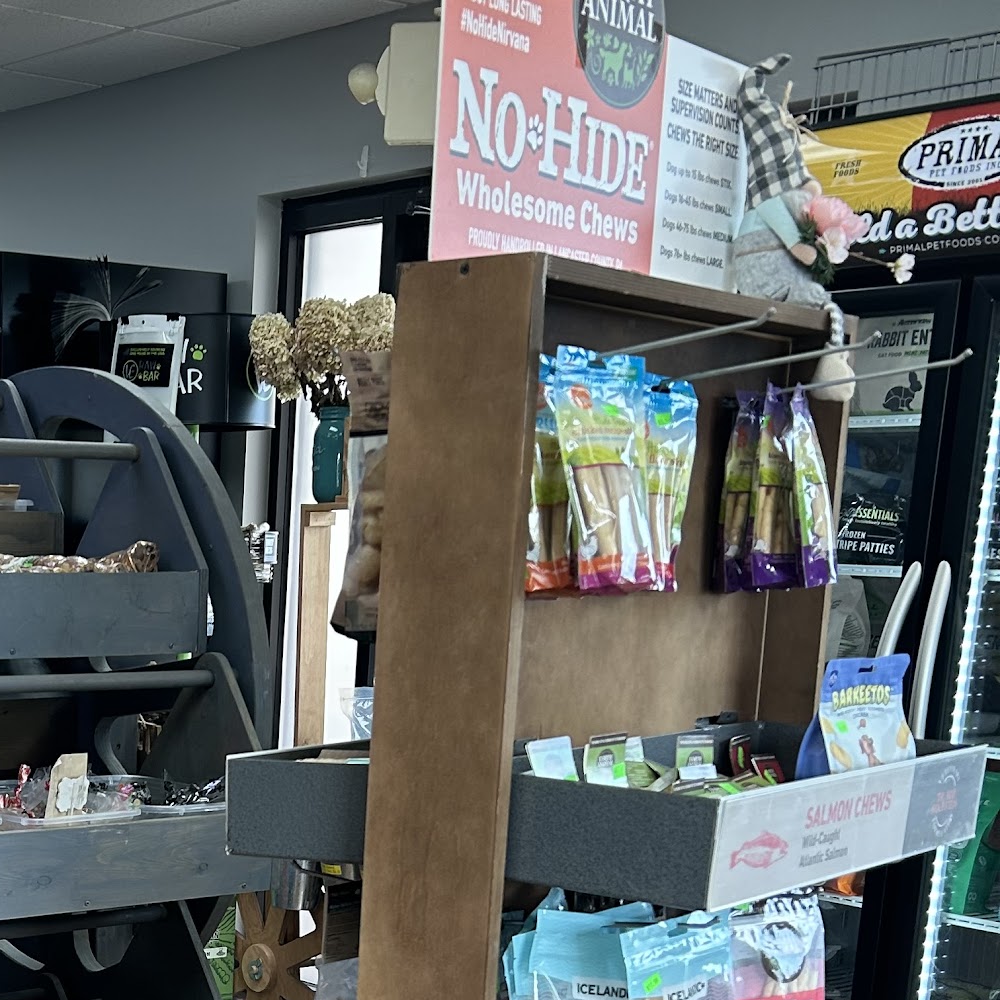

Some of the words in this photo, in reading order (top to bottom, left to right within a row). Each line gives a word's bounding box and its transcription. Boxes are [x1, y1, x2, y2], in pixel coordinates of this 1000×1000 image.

[511, 0, 542, 26] LASTING
[580, 0, 658, 43] ANIMAL
[460, 8, 530, 52] #NoHideNirvana
[678, 78, 693, 98] SIZE
[694, 84, 723, 108] MATTERS
[724, 96, 738, 114] AND
[672, 96, 714, 126] SUPERVISION
[668, 122, 690, 144] CHEWS
[692, 130, 704, 149] THE
[706, 134, 724, 155] RIGHT
[666, 162, 677, 176] Dog
[833, 168, 860, 178] FOODS
[834, 159, 862, 170] FRESH
[930, 168, 946, 178] PET
[952, 165, 982, 177] FOODS
[946, 180, 964, 188] SINCE
[456, 168, 576, 230] Wholesome
[580, 200, 638, 244] Chews
[665, 190, 678, 204] Dogs
[662, 218, 675, 232] Dogs
[894, 218, 918, 240] a
[468, 226, 500, 250] PROUDLY
[660, 245, 672, 260] Dogs
[143, 370, 160, 382] BAR
[858, 542, 896, 555] PATTIES
[832, 684, 890, 712] BARKEETOS
[804, 798, 851, 829] SALMON
[854, 790, 892, 818] CHEWS
[802, 829, 841, 850] Wild-Caught
[799, 850, 824, 868] Atlantic
[825, 846, 848, 862] Salmon
